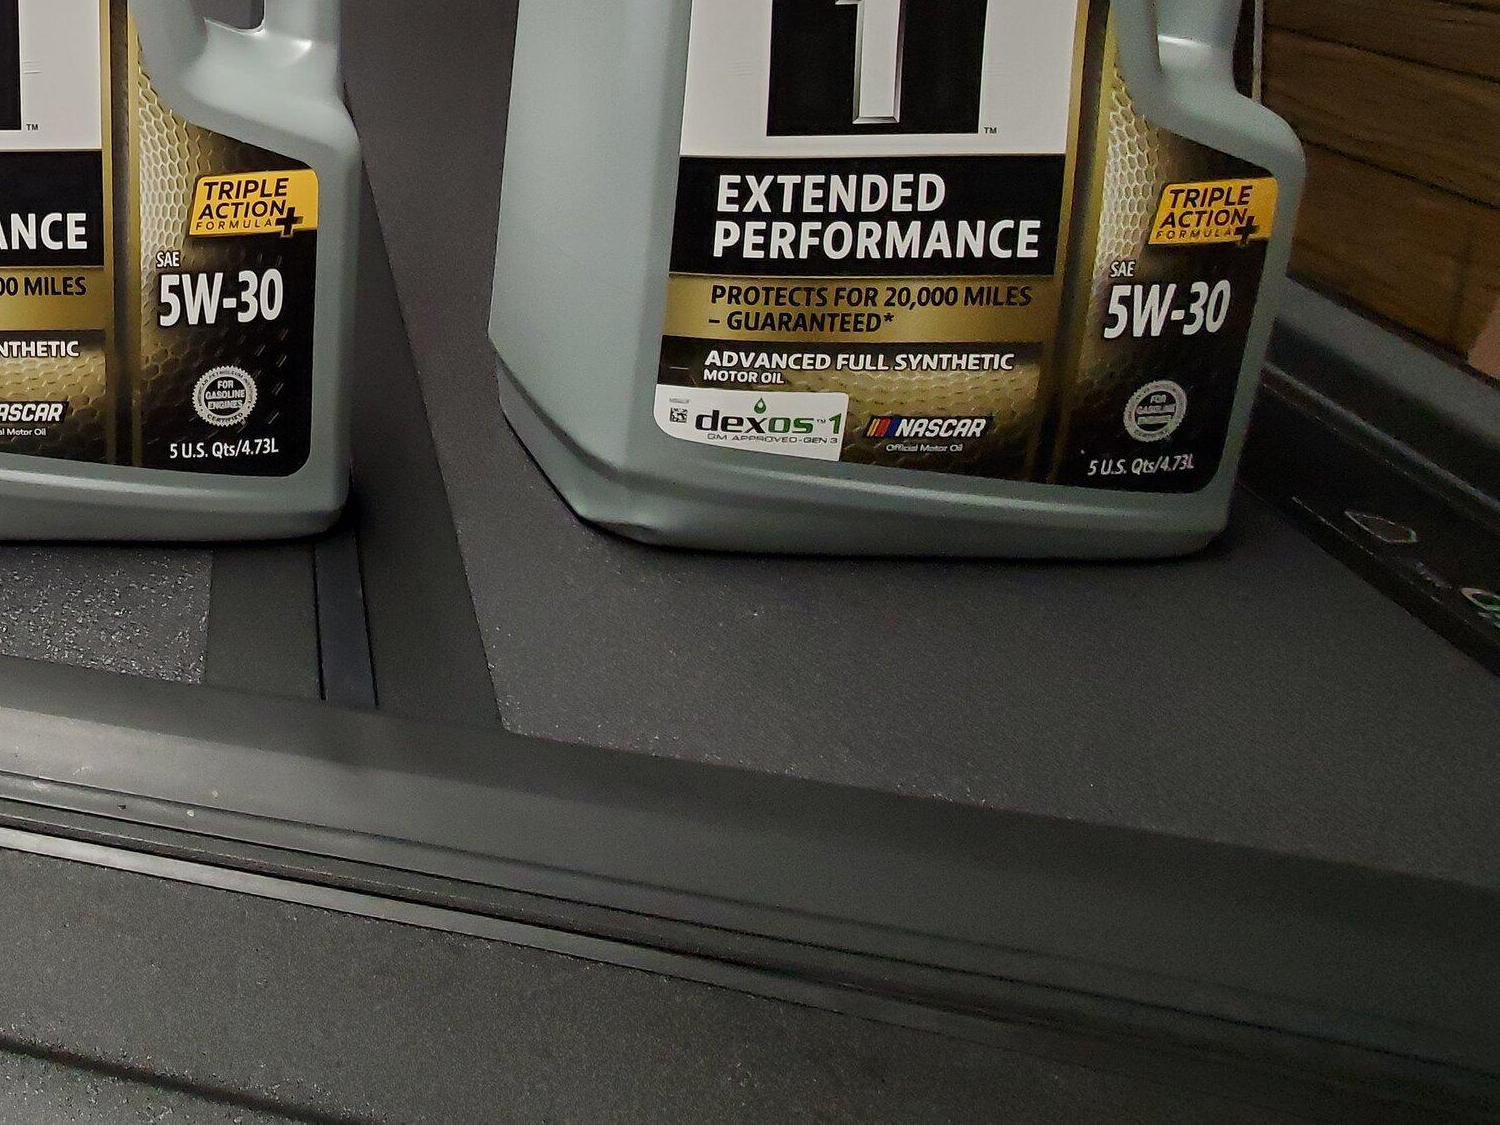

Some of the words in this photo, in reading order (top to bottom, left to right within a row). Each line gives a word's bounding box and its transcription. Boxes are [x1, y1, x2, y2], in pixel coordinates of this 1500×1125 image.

[203, 177, 290, 201] TRIPLE
[716, 173, 945, 213] EXTENDED
[1169, 185, 1253, 209] TRIPLE
[197, 199, 287, 221] ACTION
[1159, 208, 1249, 230] ACTION
[195, 219, 273, 231] FORMULA
[1155, 228, 1232, 240] FORMULA
[712, 219, 1041, 260] PERFORMANCE
[156, 251, 180, 268] SAE
[1110, 261, 1136, 277] SAE
[24, 276, 87, 296] MILES
[160, 268, 284, 327] 5W-30
[711, 285, 828, 307] PROTECTS
[834, 286, 877, 307] FOR
[884, 286, 959, 311] 20,000
[964, 285, 1032, 306] MILES
[1103, 279, 1231, 339] 5W-30
[704, 350, 831, 370] ADVANCED
[836, 353, 888, 371] FULL
[894, 353, 1015, 371] SYNTHETIC
[217, 380, 234, 389] FOR
[703, 369, 758, 383] MOTOR
[760, 371, 785, 385] OIL
[205, 389, 245, 400] GASOLINE
[6, 427, 31, 436] Motor
[34, 427, 47, 436] Oil
[894, 417, 986, 437] NASCAR
[169, 443, 178, 458] 5
[182, 442, 208, 458] U.S.
[212, 438, 279, 458] Qts/4.73L
[920, 442, 947, 452] Motor
[949, 442, 963, 452] Oil
[1087, 460, 1099, 475] 5
[1100, 458, 1128, 475] U.S.
